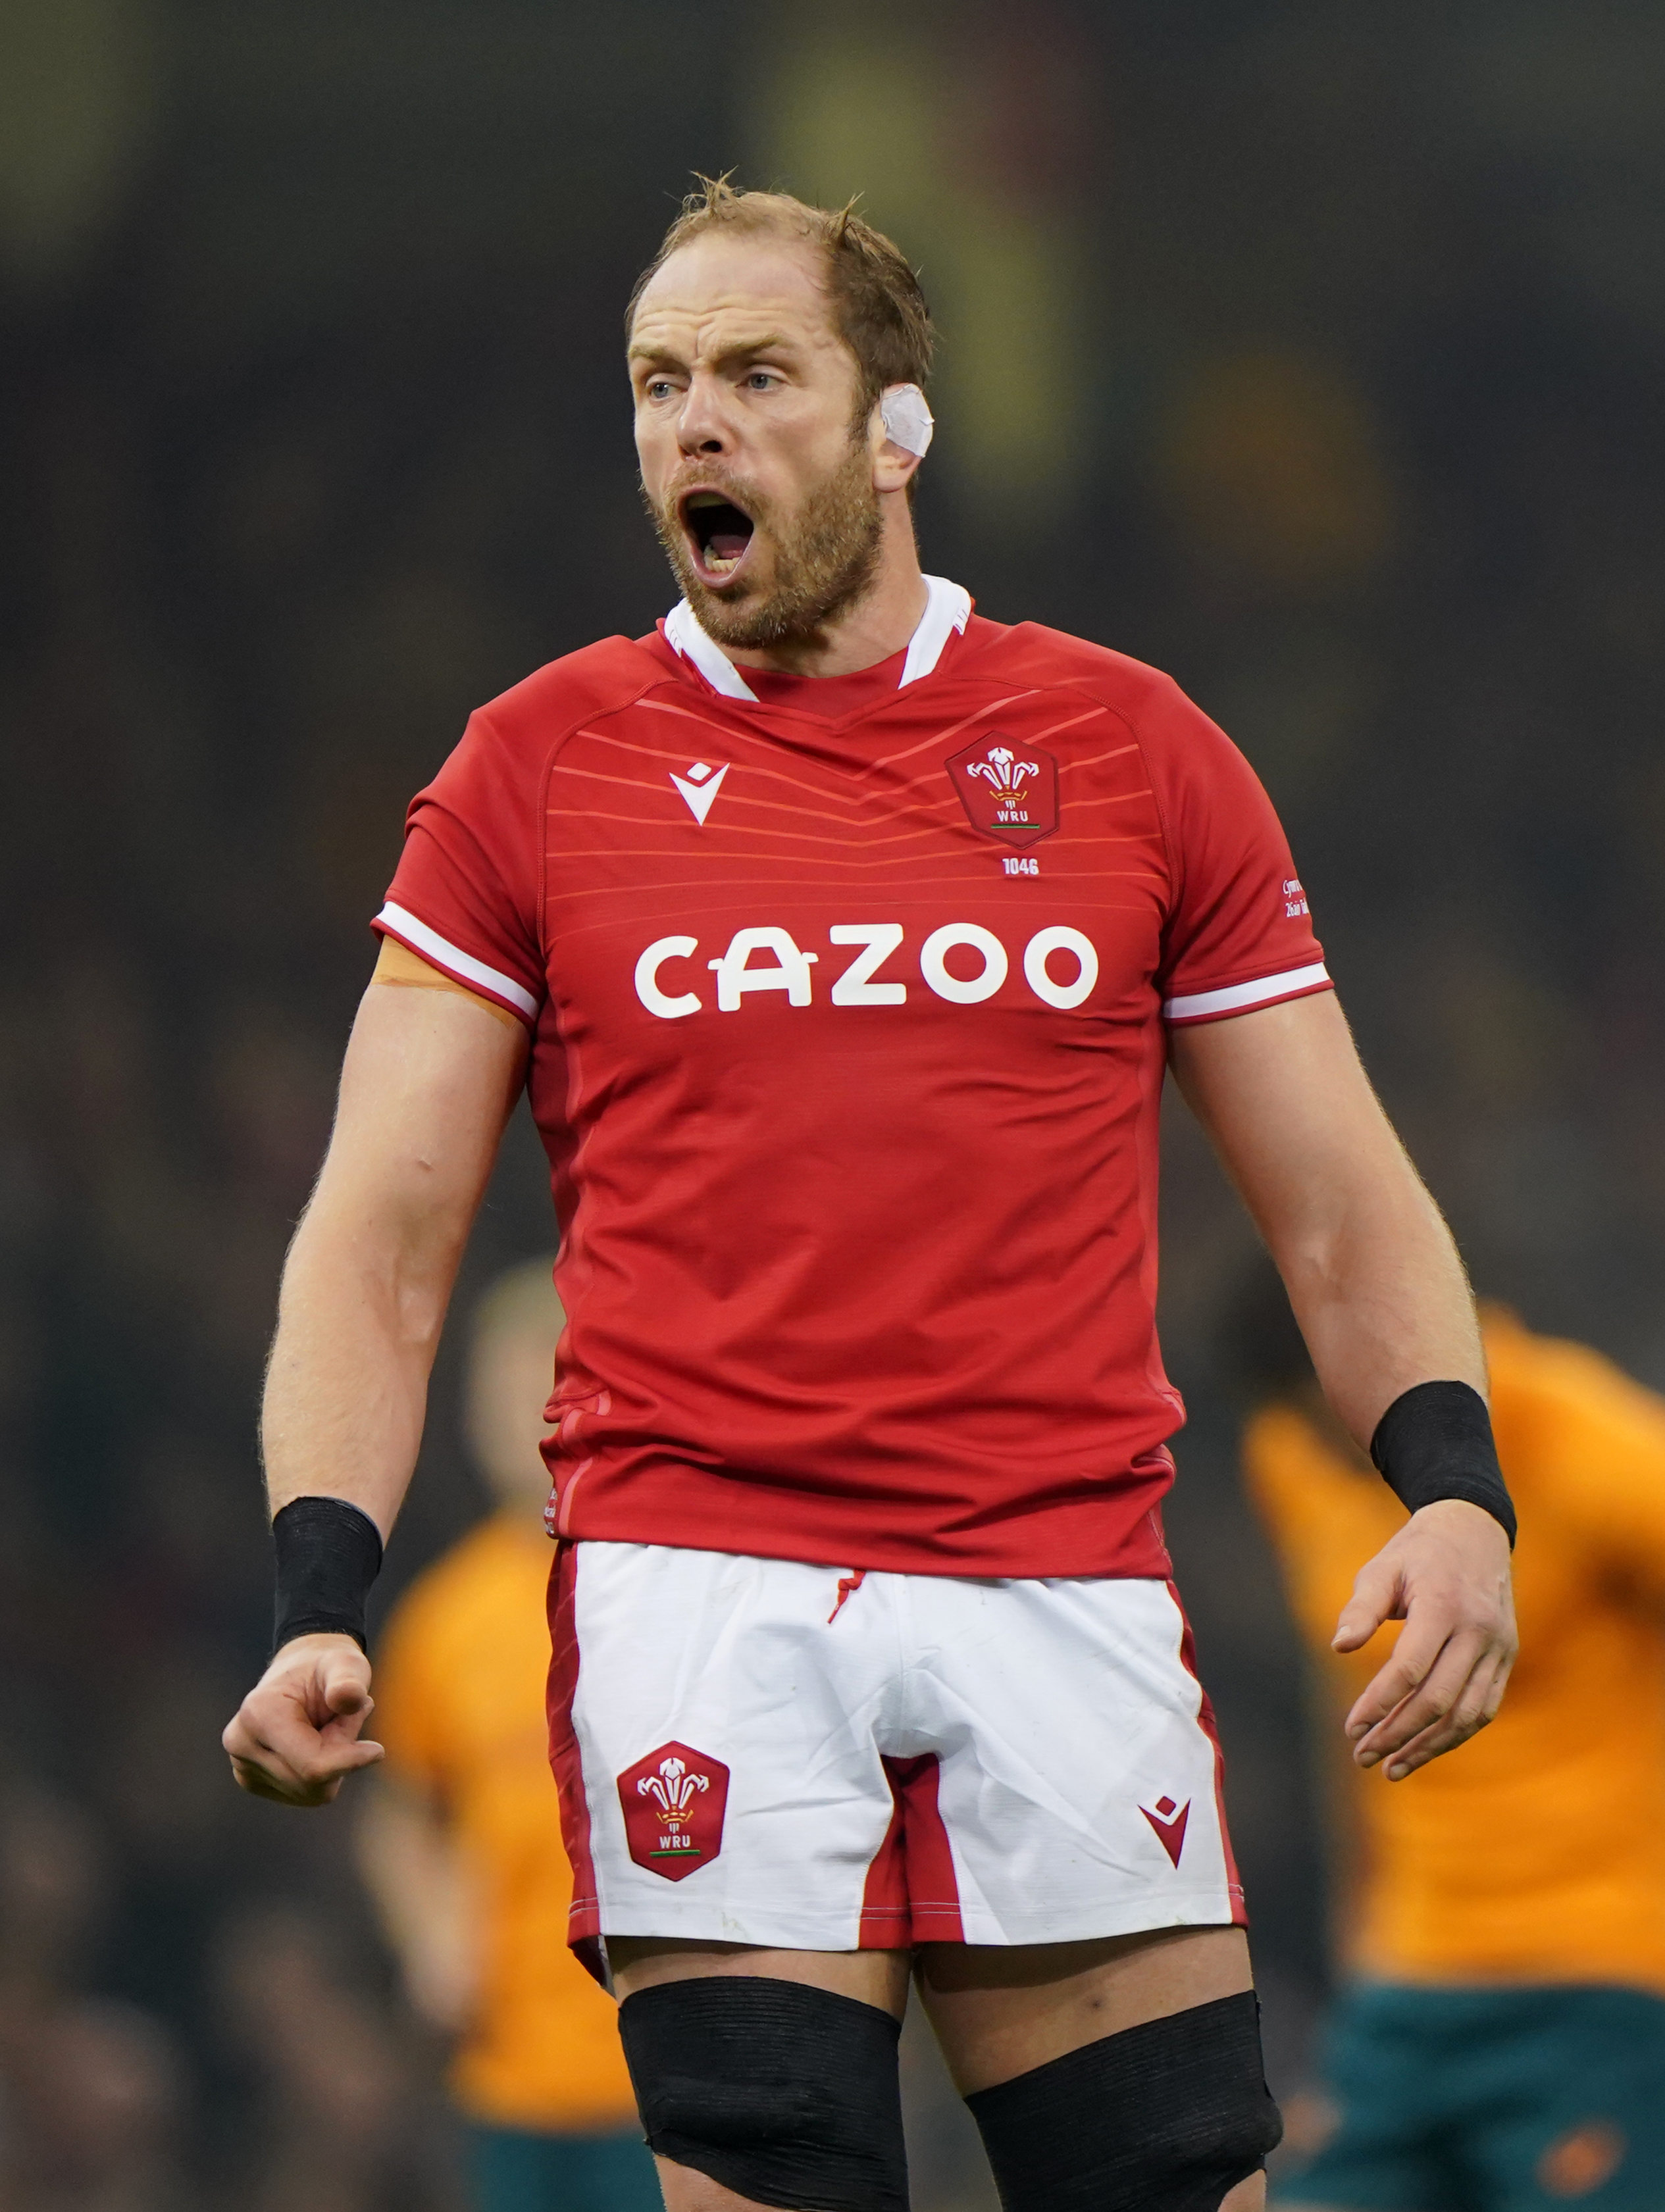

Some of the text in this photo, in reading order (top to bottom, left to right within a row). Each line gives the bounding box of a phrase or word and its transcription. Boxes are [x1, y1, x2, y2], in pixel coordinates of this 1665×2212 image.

[996, 811, 1029, 822] WRU
[1002, 857, 1039, 875] 1046
[634, 922, 1098, 1018] CAZOO
[659, 1835, 690, 1849] WRU
